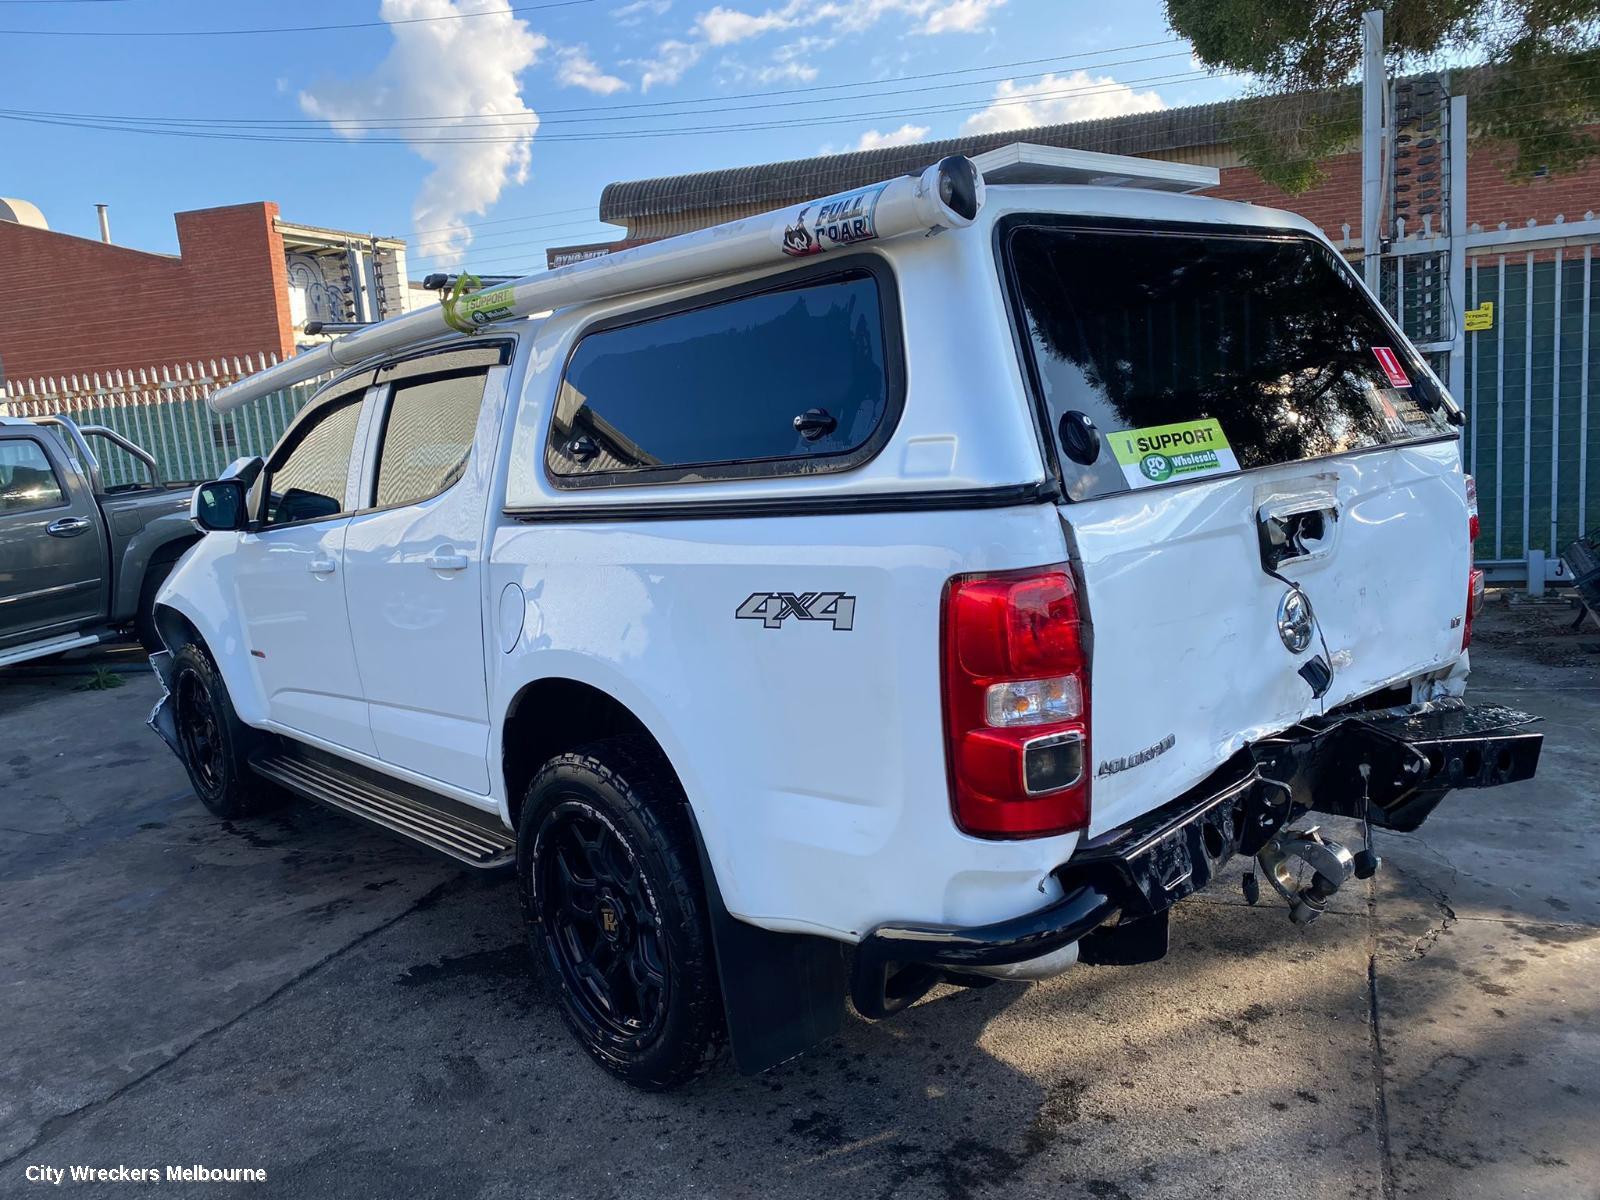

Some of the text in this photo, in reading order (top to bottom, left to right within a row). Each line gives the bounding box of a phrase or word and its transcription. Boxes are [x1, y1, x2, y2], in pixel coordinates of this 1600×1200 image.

[815, 195, 864, 226] FULL
[470, 289, 511, 309] SUPPORT
[1126, 428, 1214, 454] I SUPPORT
[1146, 456, 1166, 477] go
[1171, 450, 1217, 467] Wholesale
